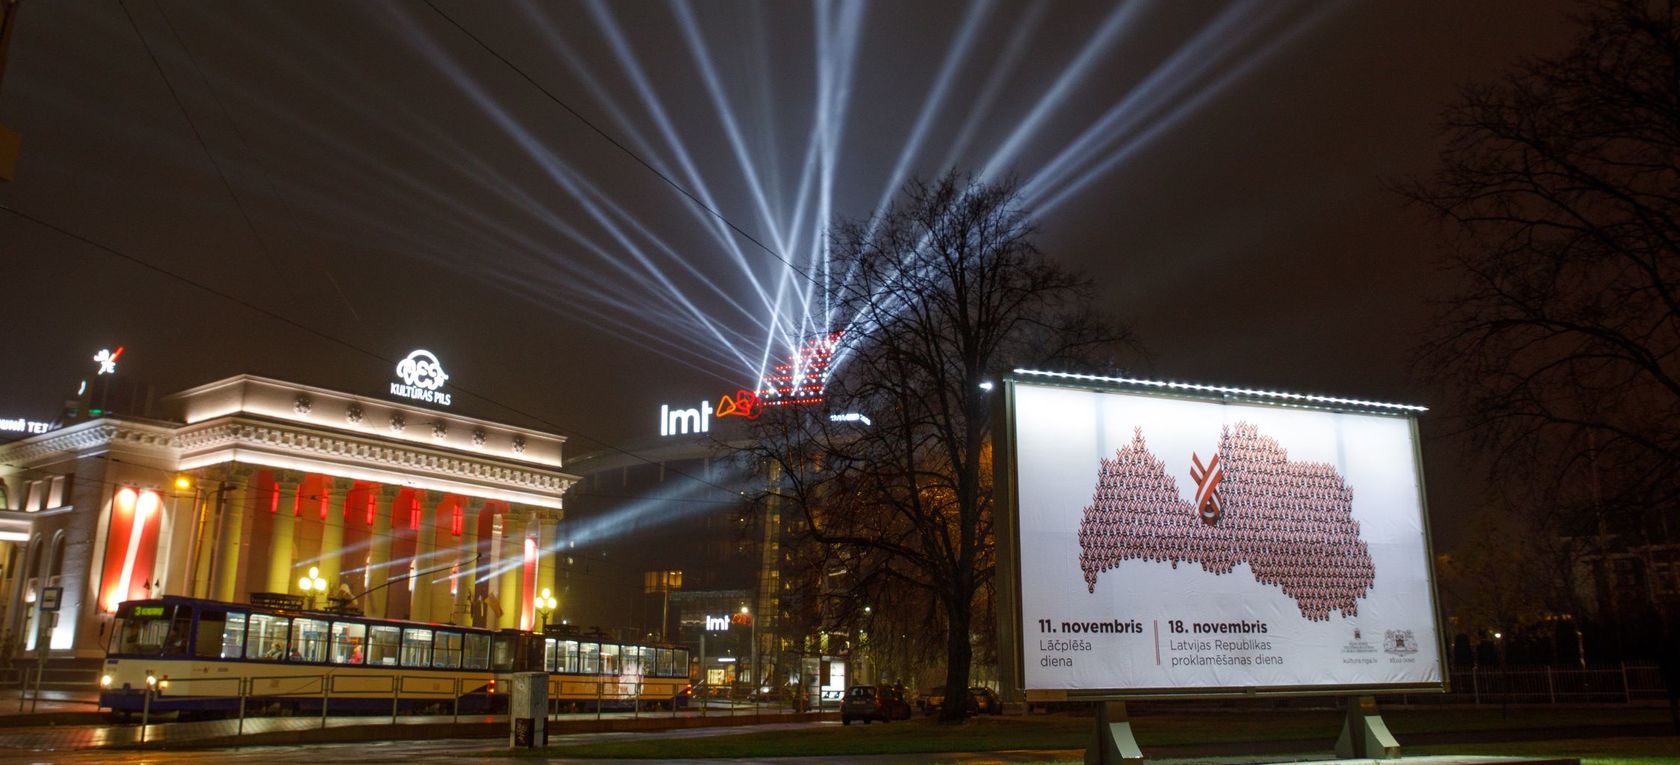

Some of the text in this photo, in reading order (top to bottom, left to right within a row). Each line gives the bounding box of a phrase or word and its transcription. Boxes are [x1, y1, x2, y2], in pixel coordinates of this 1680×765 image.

[390, 382, 451, 406] KULTŪRAS PILS
[661, 400, 712, 437] lmt
[706, 615, 731, 631] lmt
[1038, 619, 1143, 634] 11. novembris
[1168, 620, 1268, 634] 18. novembris
[1040, 639, 1092, 653] Lāčplēša
[1170, 639, 1272, 653] Latvijas Republikas
[1040, 655, 1073, 667] diena
[1171, 653, 1284, 667] proklamēšanas diena
